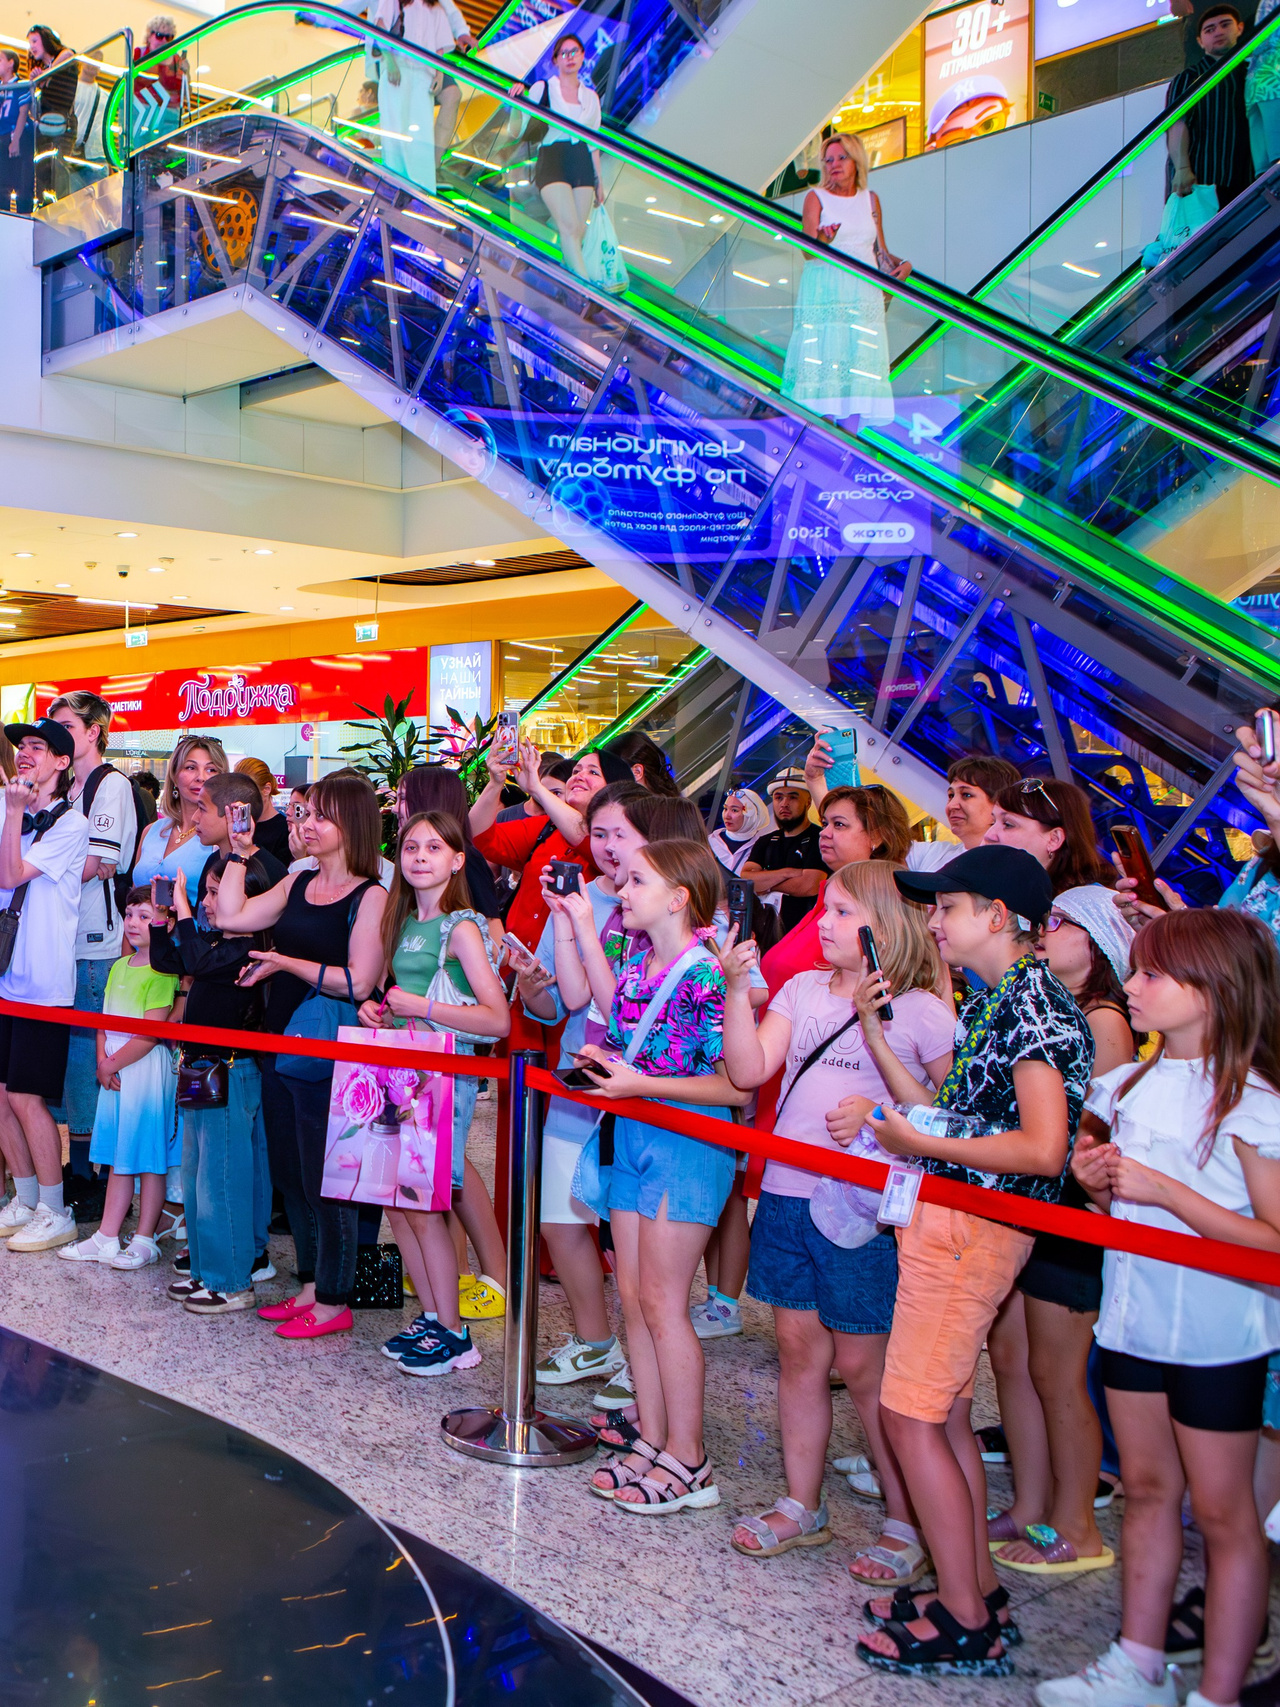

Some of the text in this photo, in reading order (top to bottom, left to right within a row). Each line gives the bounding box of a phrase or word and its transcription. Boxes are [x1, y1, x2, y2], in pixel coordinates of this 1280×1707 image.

[952, 3, 1011, 56] 30+
[938, 40, 1013, 80] АТТРАКЦИОНОВ
[440, 652, 482, 670] УЗНАЙ
[440, 670, 481, 685] НАШИ
[177, 673, 297, 722] Подружка
[440, 685, 482, 700] ТАЙНЫ!
[797, 1015, 866, 1056] NO
[821, 1056, 861, 1071] added
